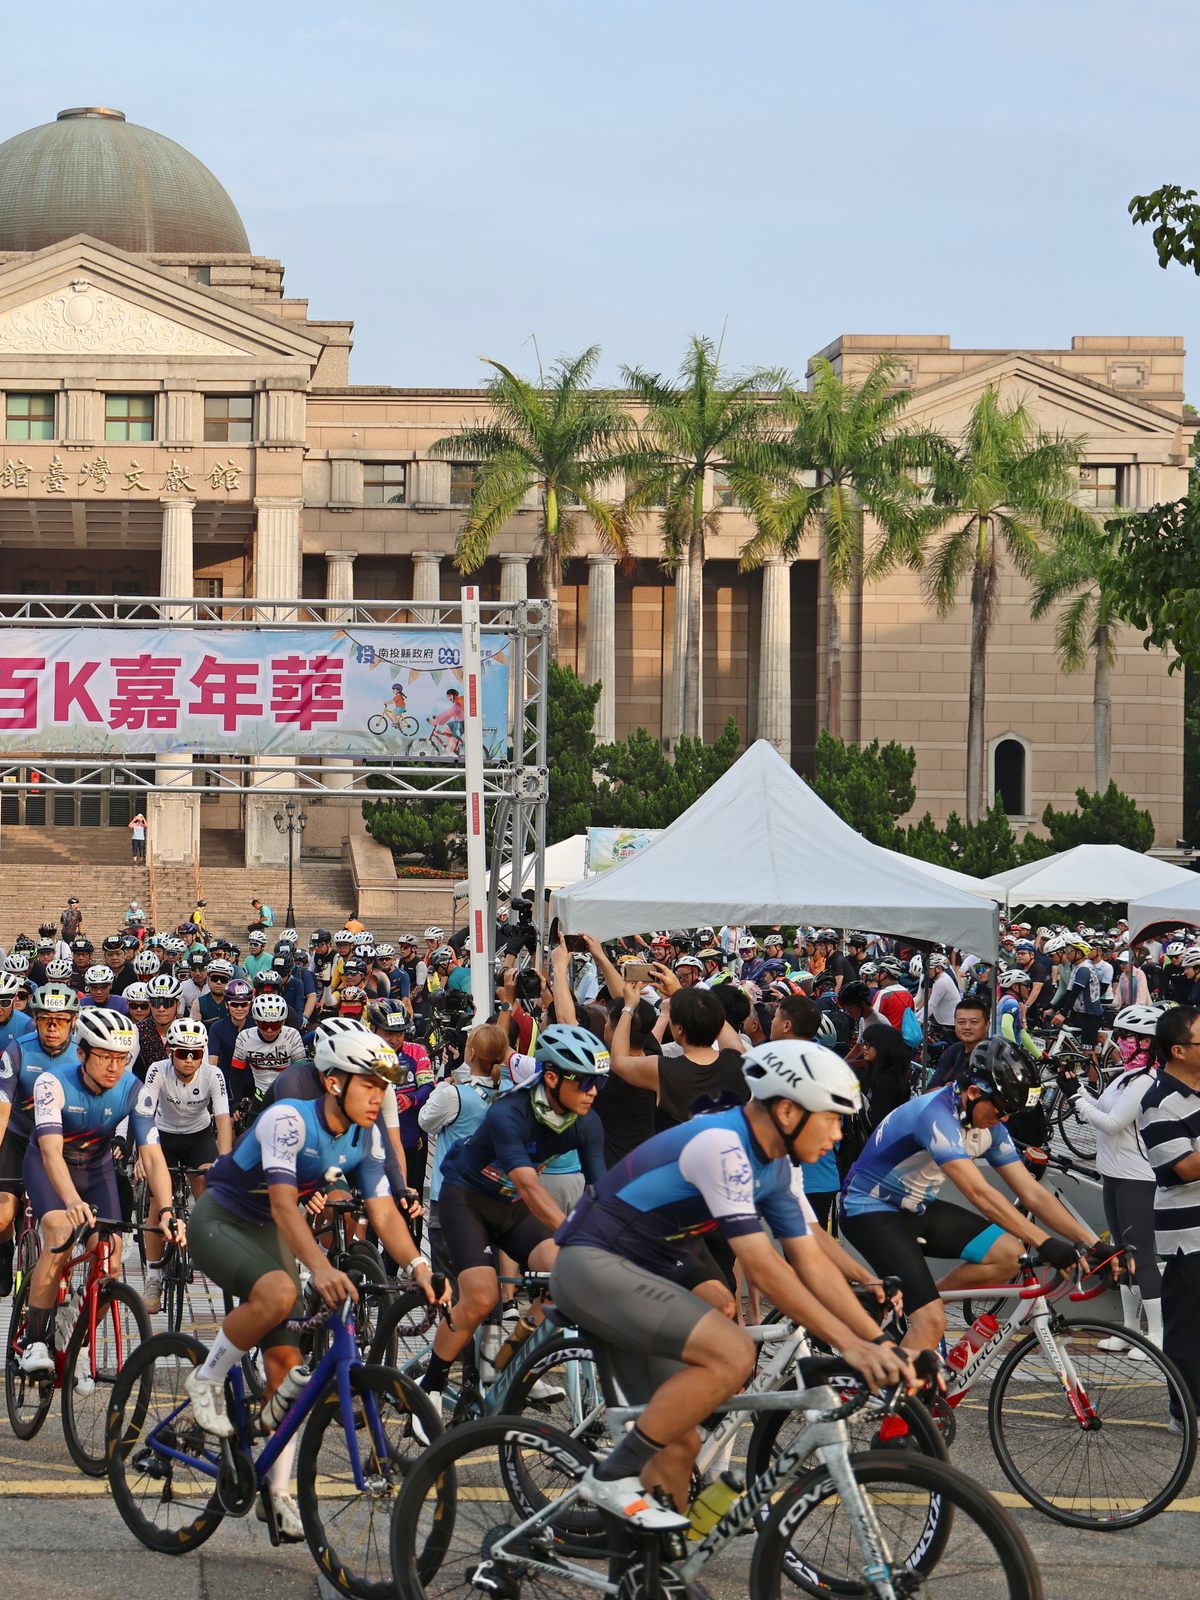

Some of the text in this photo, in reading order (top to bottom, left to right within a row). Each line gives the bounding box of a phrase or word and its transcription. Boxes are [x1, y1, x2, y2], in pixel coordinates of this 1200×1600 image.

[378, 648, 434, 659] 南投縣政府
[182, 1035, 199, 1043] 1722
[762, 1052, 803, 1089] KASK
[700, 1449, 801, 1555] S-WORKS
